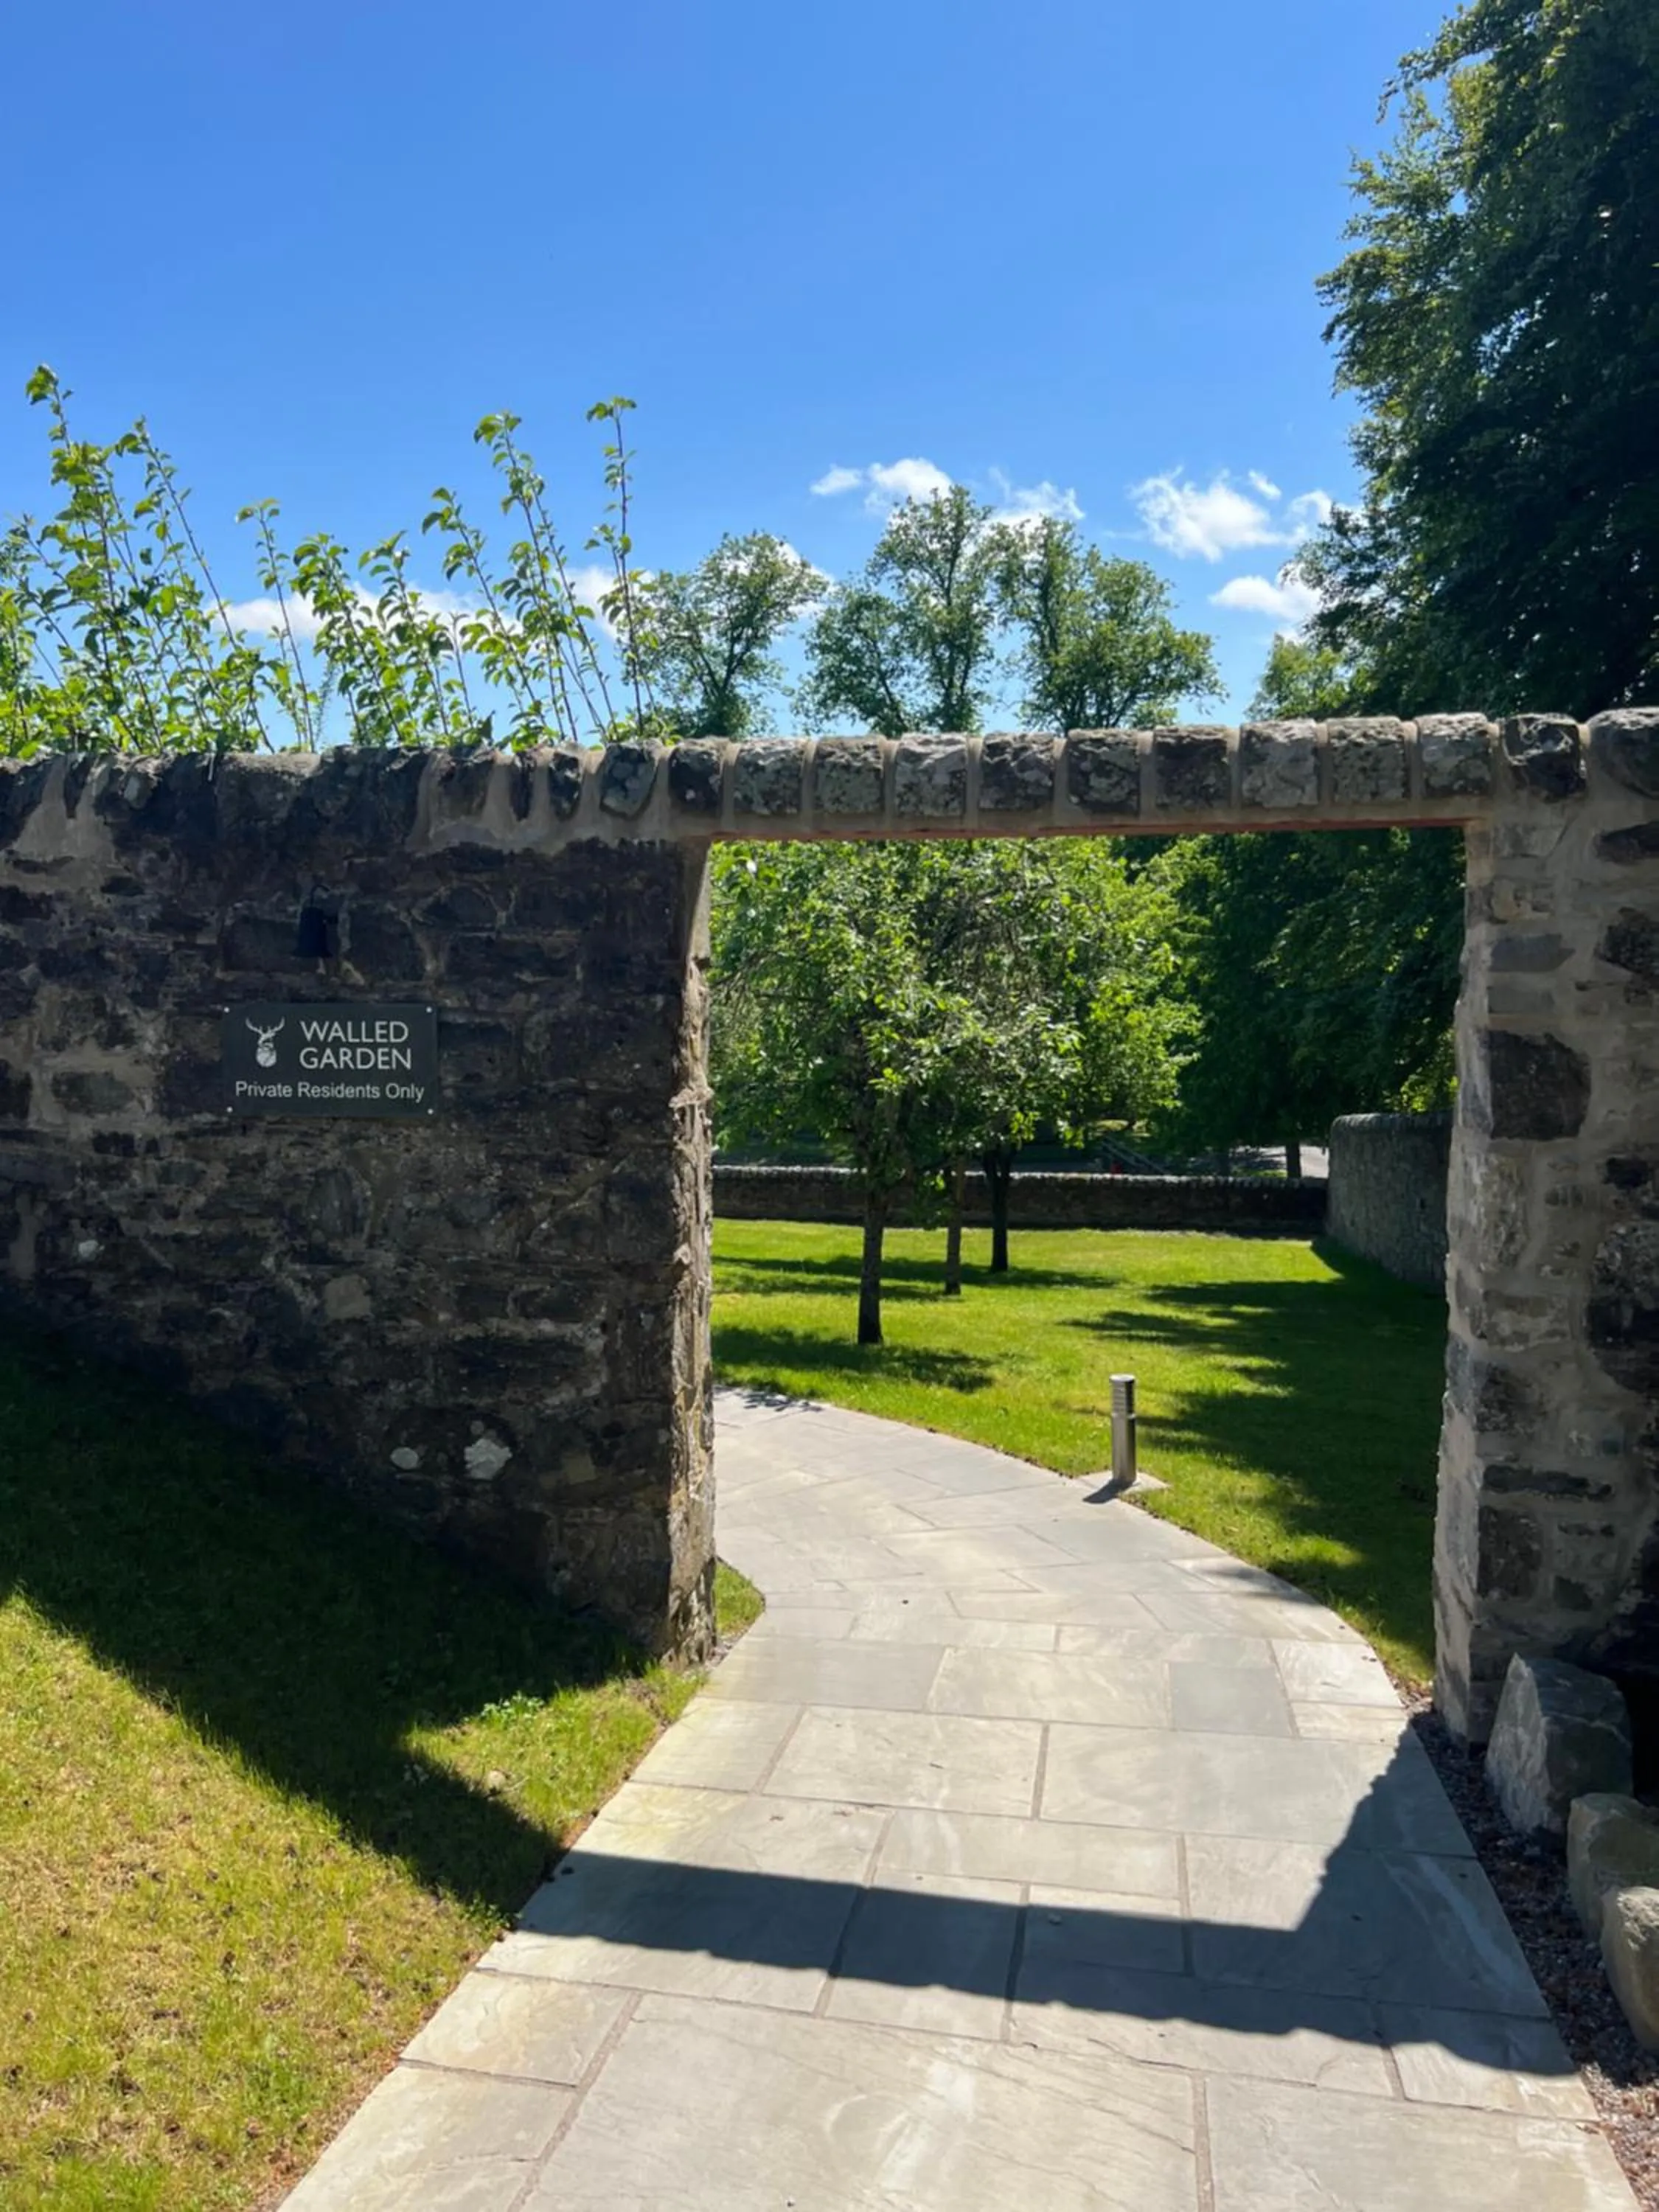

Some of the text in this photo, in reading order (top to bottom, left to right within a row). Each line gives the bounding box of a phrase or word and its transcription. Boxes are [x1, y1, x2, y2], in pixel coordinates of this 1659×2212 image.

[300, 1020, 408, 1043] WALLED
[299, 1047, 411, 1069] GARDEN
[235, 1081, 425, 1103] Private Residents Only
